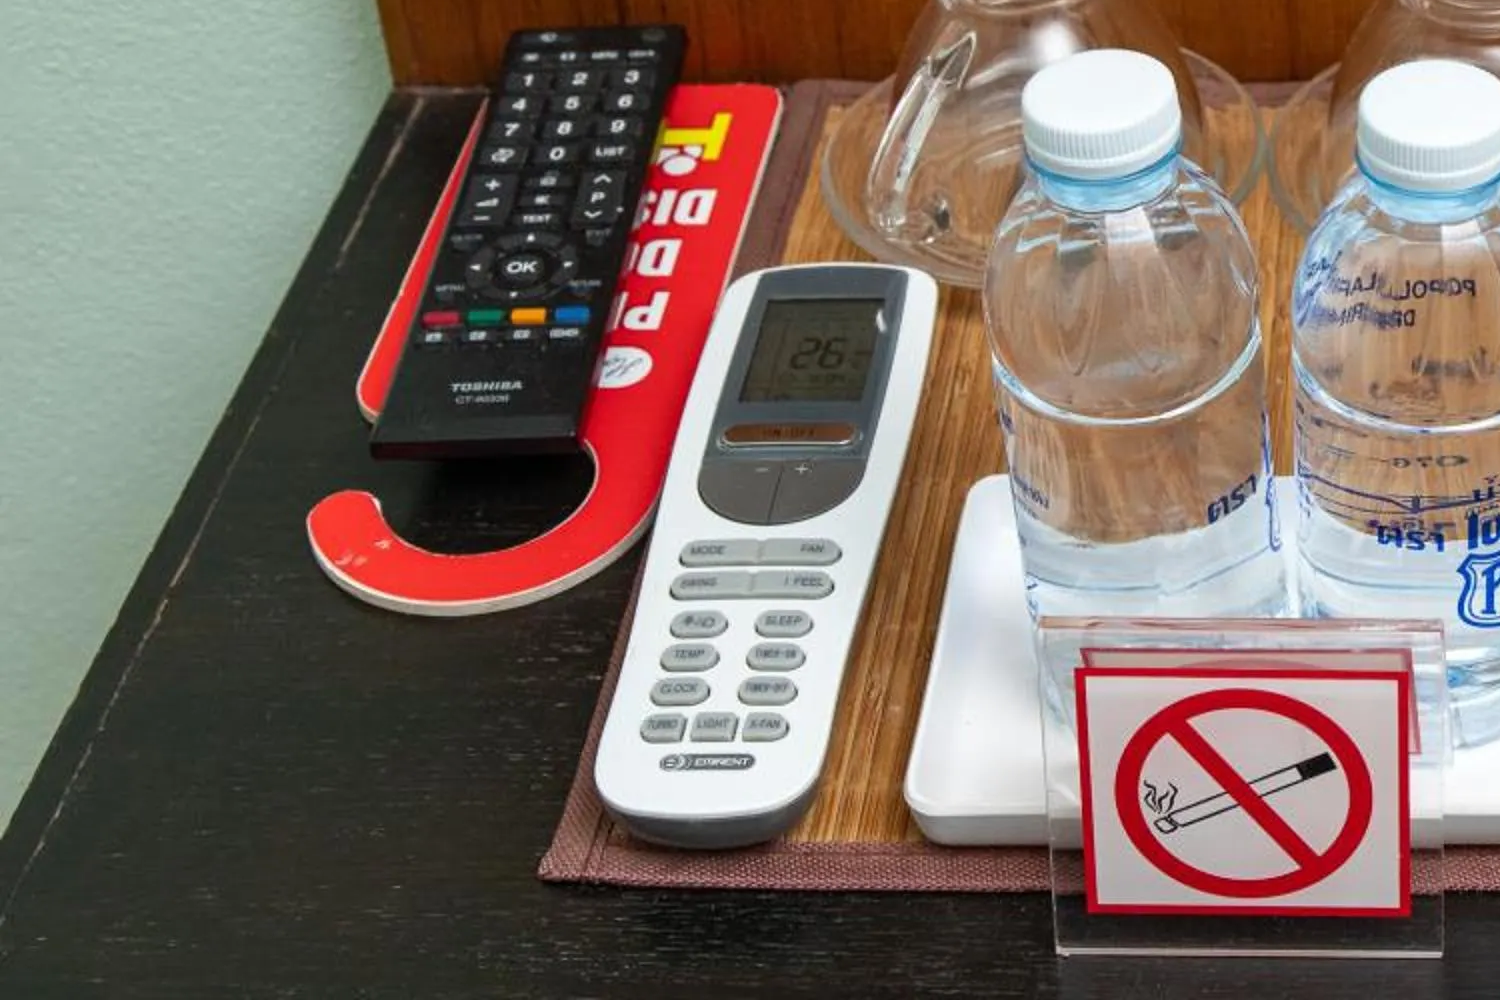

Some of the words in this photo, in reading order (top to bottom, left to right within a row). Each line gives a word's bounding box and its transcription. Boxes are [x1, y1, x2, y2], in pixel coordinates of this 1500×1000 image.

[523, 73, 535, 87] 1
[571, 71, 589, 86] 2
[624, 69, 640, 84] 3
[511, 98, 527, 111] 4
[564, 96, 580, 110] 5
[617, 94, 634, 109] 6
[504, 122, 520, 137] 7
[557, 121, 573, 135] 8
[610, 119, 626, 133] 9
[549, 146, 565, 161] 0
[506, 260, 538, 275] OK
[790, 336, 848, 371] 26
[451, 380, 523, 393] TOSHIBA
[690, 545, 727, 555] MODE
[800, 543, 825, 553] FAN
[765, 615, 803, 626] SLEEP
[674, 649, 705, 659] TEMP
[660, 683, 699, 695] CLOCK
[647, 719, 679, 730] TURBO
[696, 717, 730, 729] LIGHT
